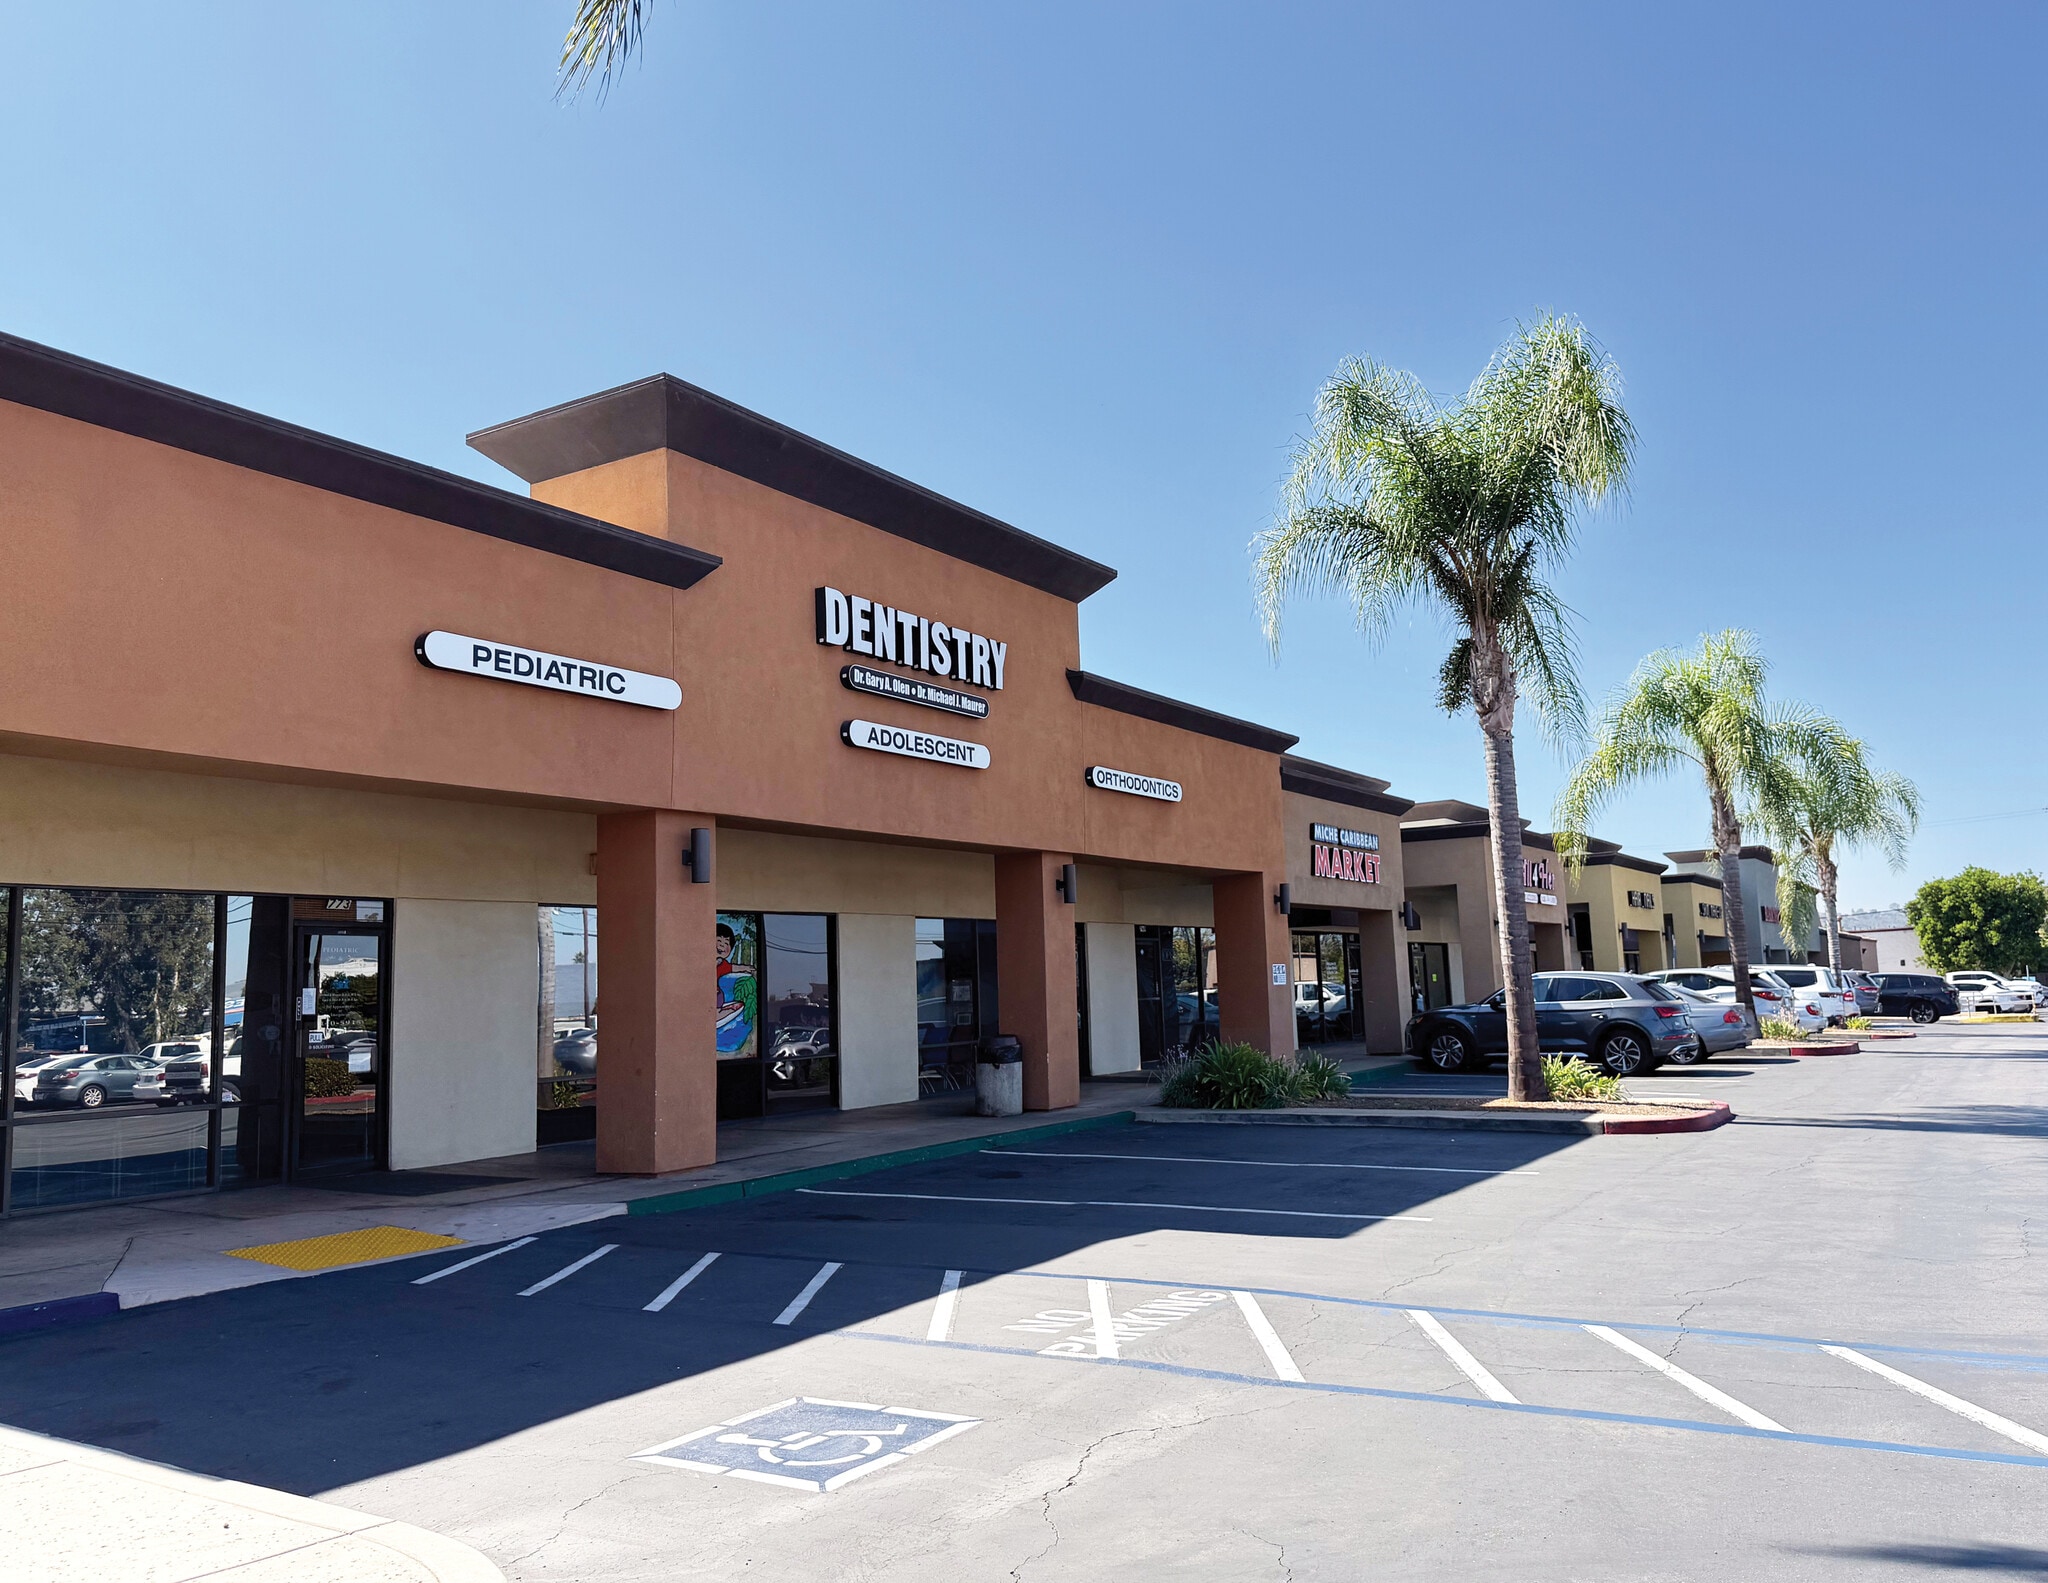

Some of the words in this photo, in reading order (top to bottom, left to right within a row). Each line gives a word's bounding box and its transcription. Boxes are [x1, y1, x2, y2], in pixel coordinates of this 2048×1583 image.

[823, 586, 1008, 690] DENTISTRY
[472, 644, 626, 694] PEDIATRIC
[854, 669, 865, 684] Dr.
[865, 672, 885, 690] Gary
[885, 677, 892, 691] A.
[893, 679, 910, 696] Olen
[917, 685, 927, 700] Dr.
[928, 687, 955, 707] Michael
[955, 695, 961, 708] J.
[961, 697, 986, 714] Maurer
[867, 727, 975, 763] ADOLESCENT
[1096, 770, 1179, 799] ORTHODONTICS
[1314, 824, 1338, 842] MICHE
[1340, 828, 1379, 850] CARIBBEAN
[1313, 844, 1380, 884] MARKET
[1532, 863, 1539, 887] 4
[309, 1034, 322, 1042] PULL
[1001, 1309, 1092, 1334] NO
